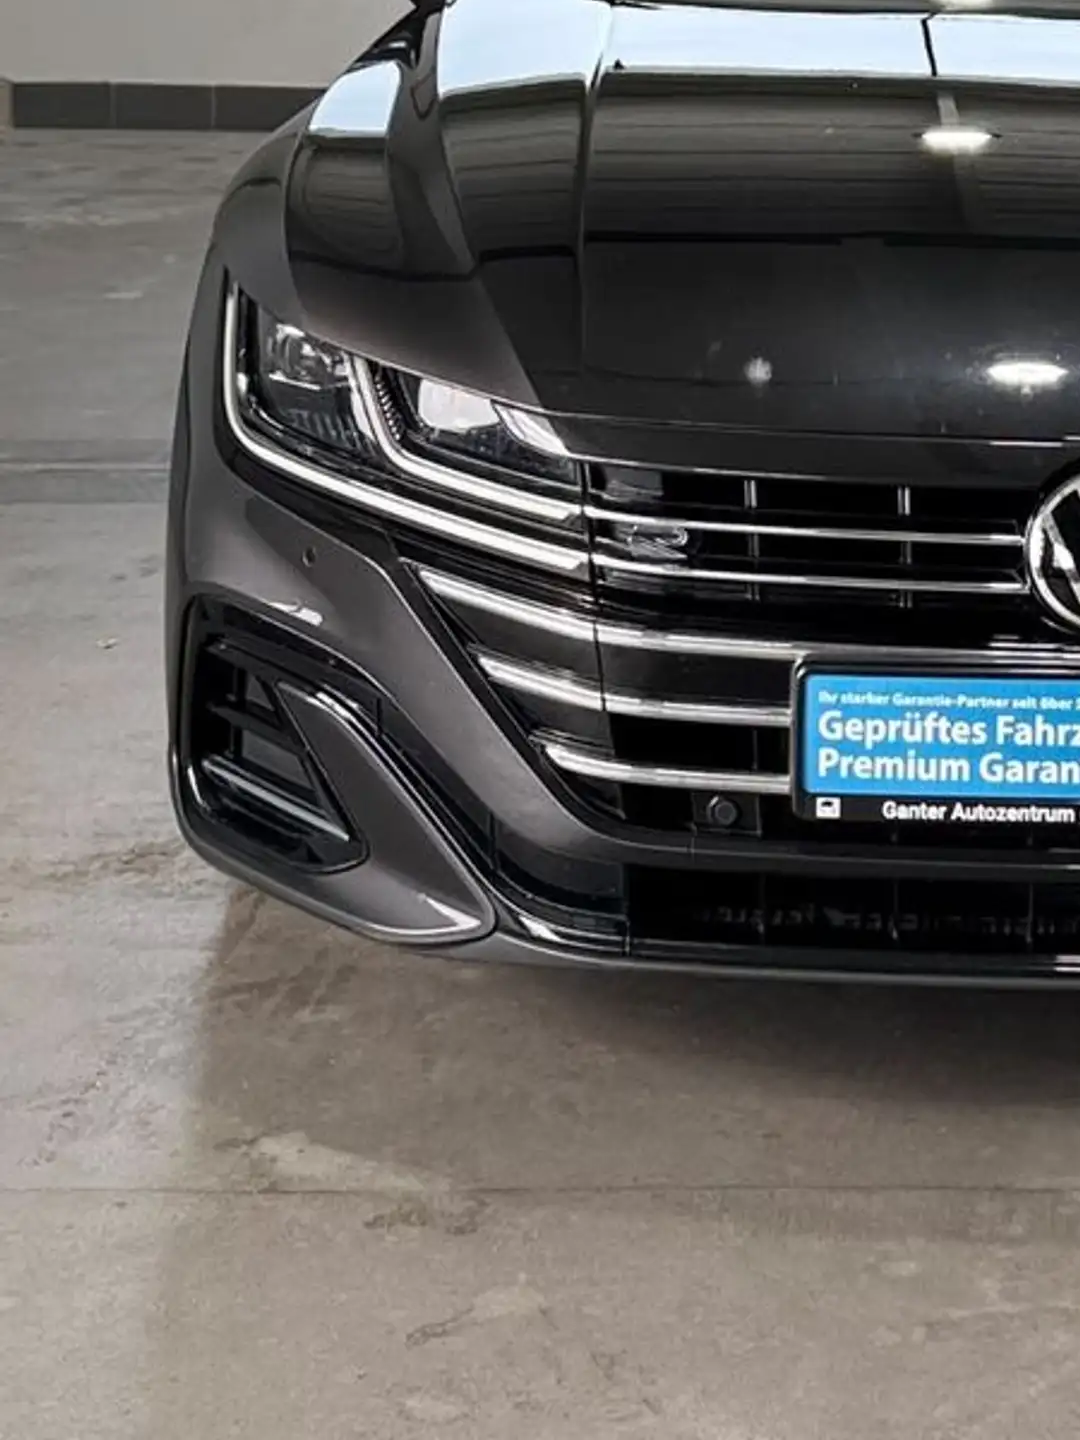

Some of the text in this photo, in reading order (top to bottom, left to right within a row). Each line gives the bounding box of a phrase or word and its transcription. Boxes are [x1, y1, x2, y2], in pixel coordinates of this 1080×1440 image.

[818, 710, 988, 749] Geprüftes
[818, 748, 970, 783] Premium
[882, 801, 946, 821] Ganter
[951, 803, 1075, 823] Autozentrum
